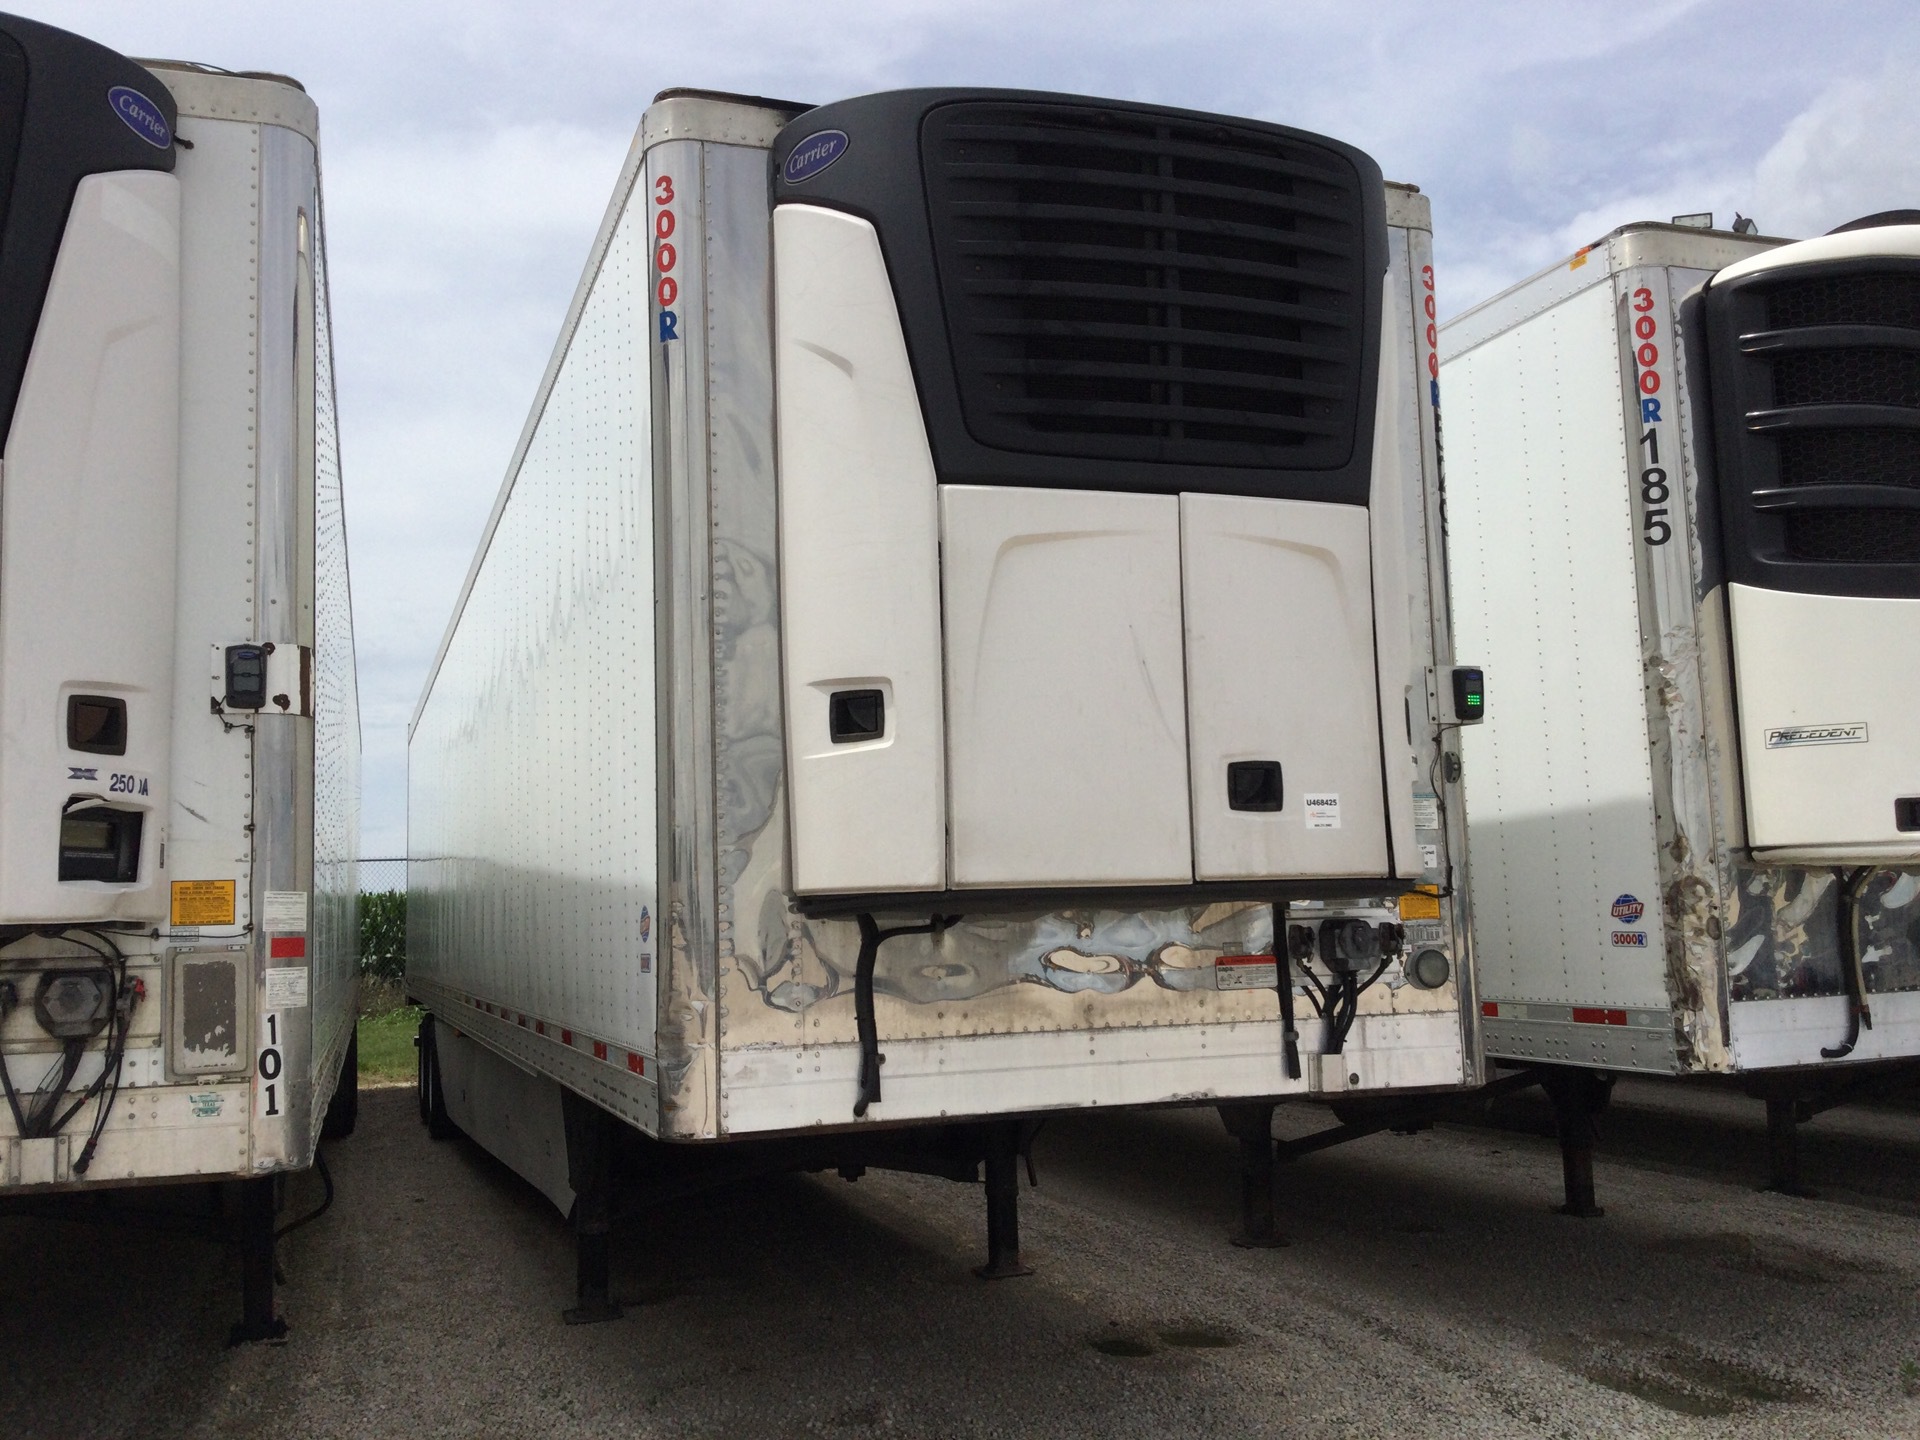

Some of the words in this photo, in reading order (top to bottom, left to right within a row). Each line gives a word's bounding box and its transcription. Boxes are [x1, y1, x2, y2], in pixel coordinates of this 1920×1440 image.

[119, 95, 166, 137] Carrier
[789, 139, 837, 173] Carrier
[655, 175, 679, 342] 3000R
[1633, 287, 1662, 424] 3000R
[1640, 428, 1672, 546] 185
[1769, 726, 1864, 742] PRECEDENT
[1613, 903, 1642, 916] UTILITY
[258, 1013, 283, 1115] 101
